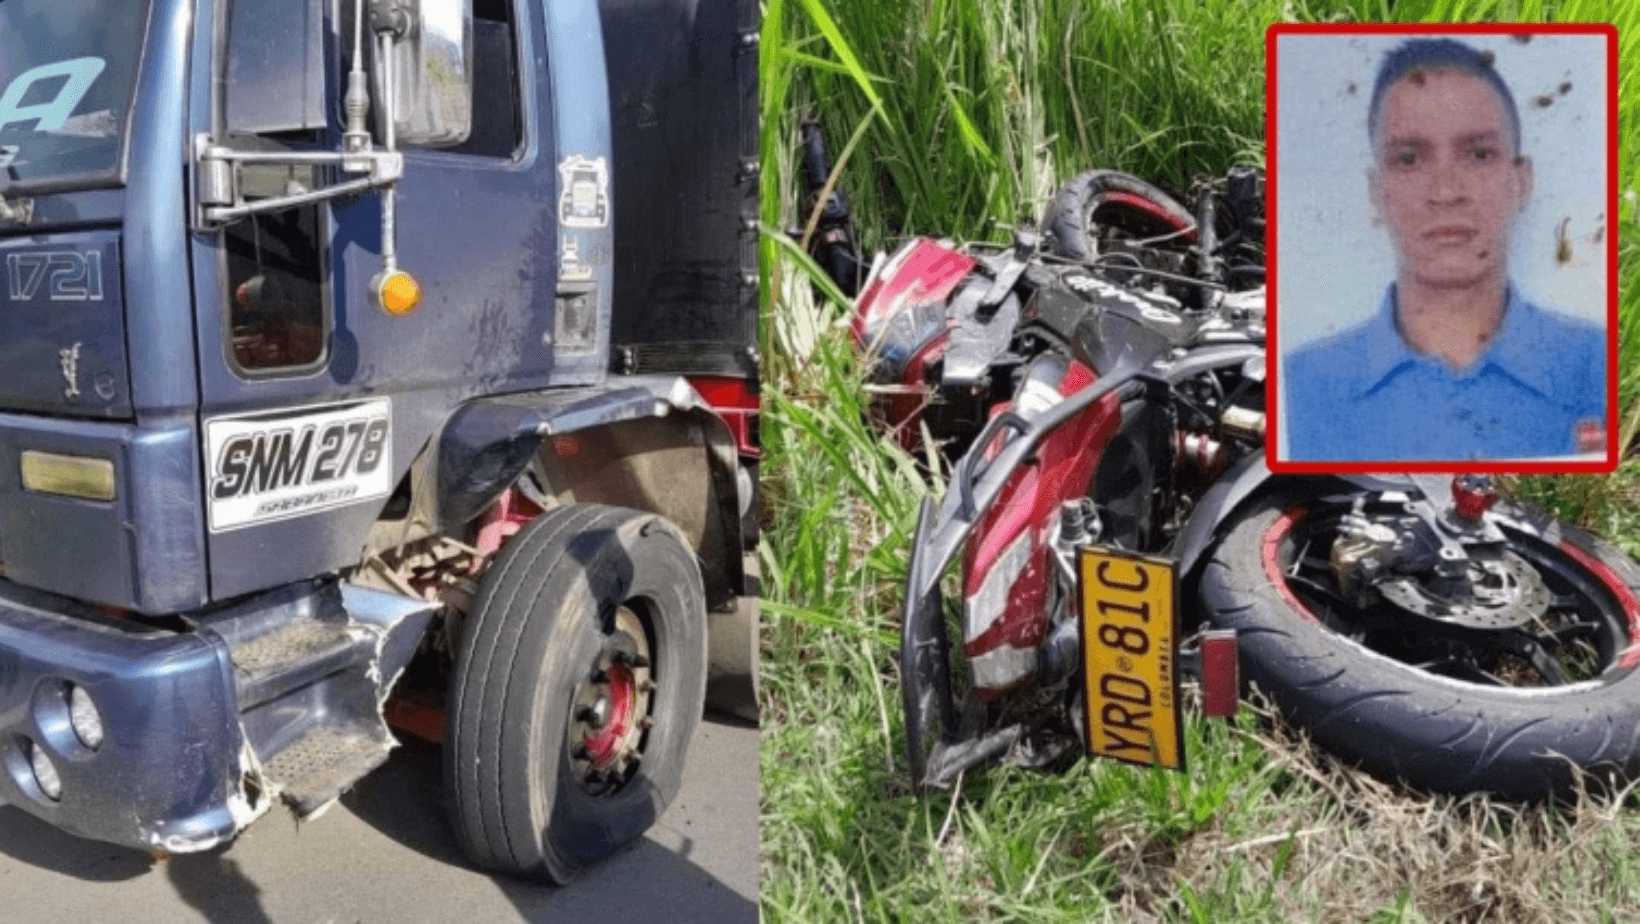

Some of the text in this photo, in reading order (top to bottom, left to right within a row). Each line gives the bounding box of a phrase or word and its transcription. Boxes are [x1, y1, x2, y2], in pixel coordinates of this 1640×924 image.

[6, 249, 103, 301] 1721
[213, 418, 389, 499] SNM 278
[1096, 560, 1153, 753] YRD 81C
